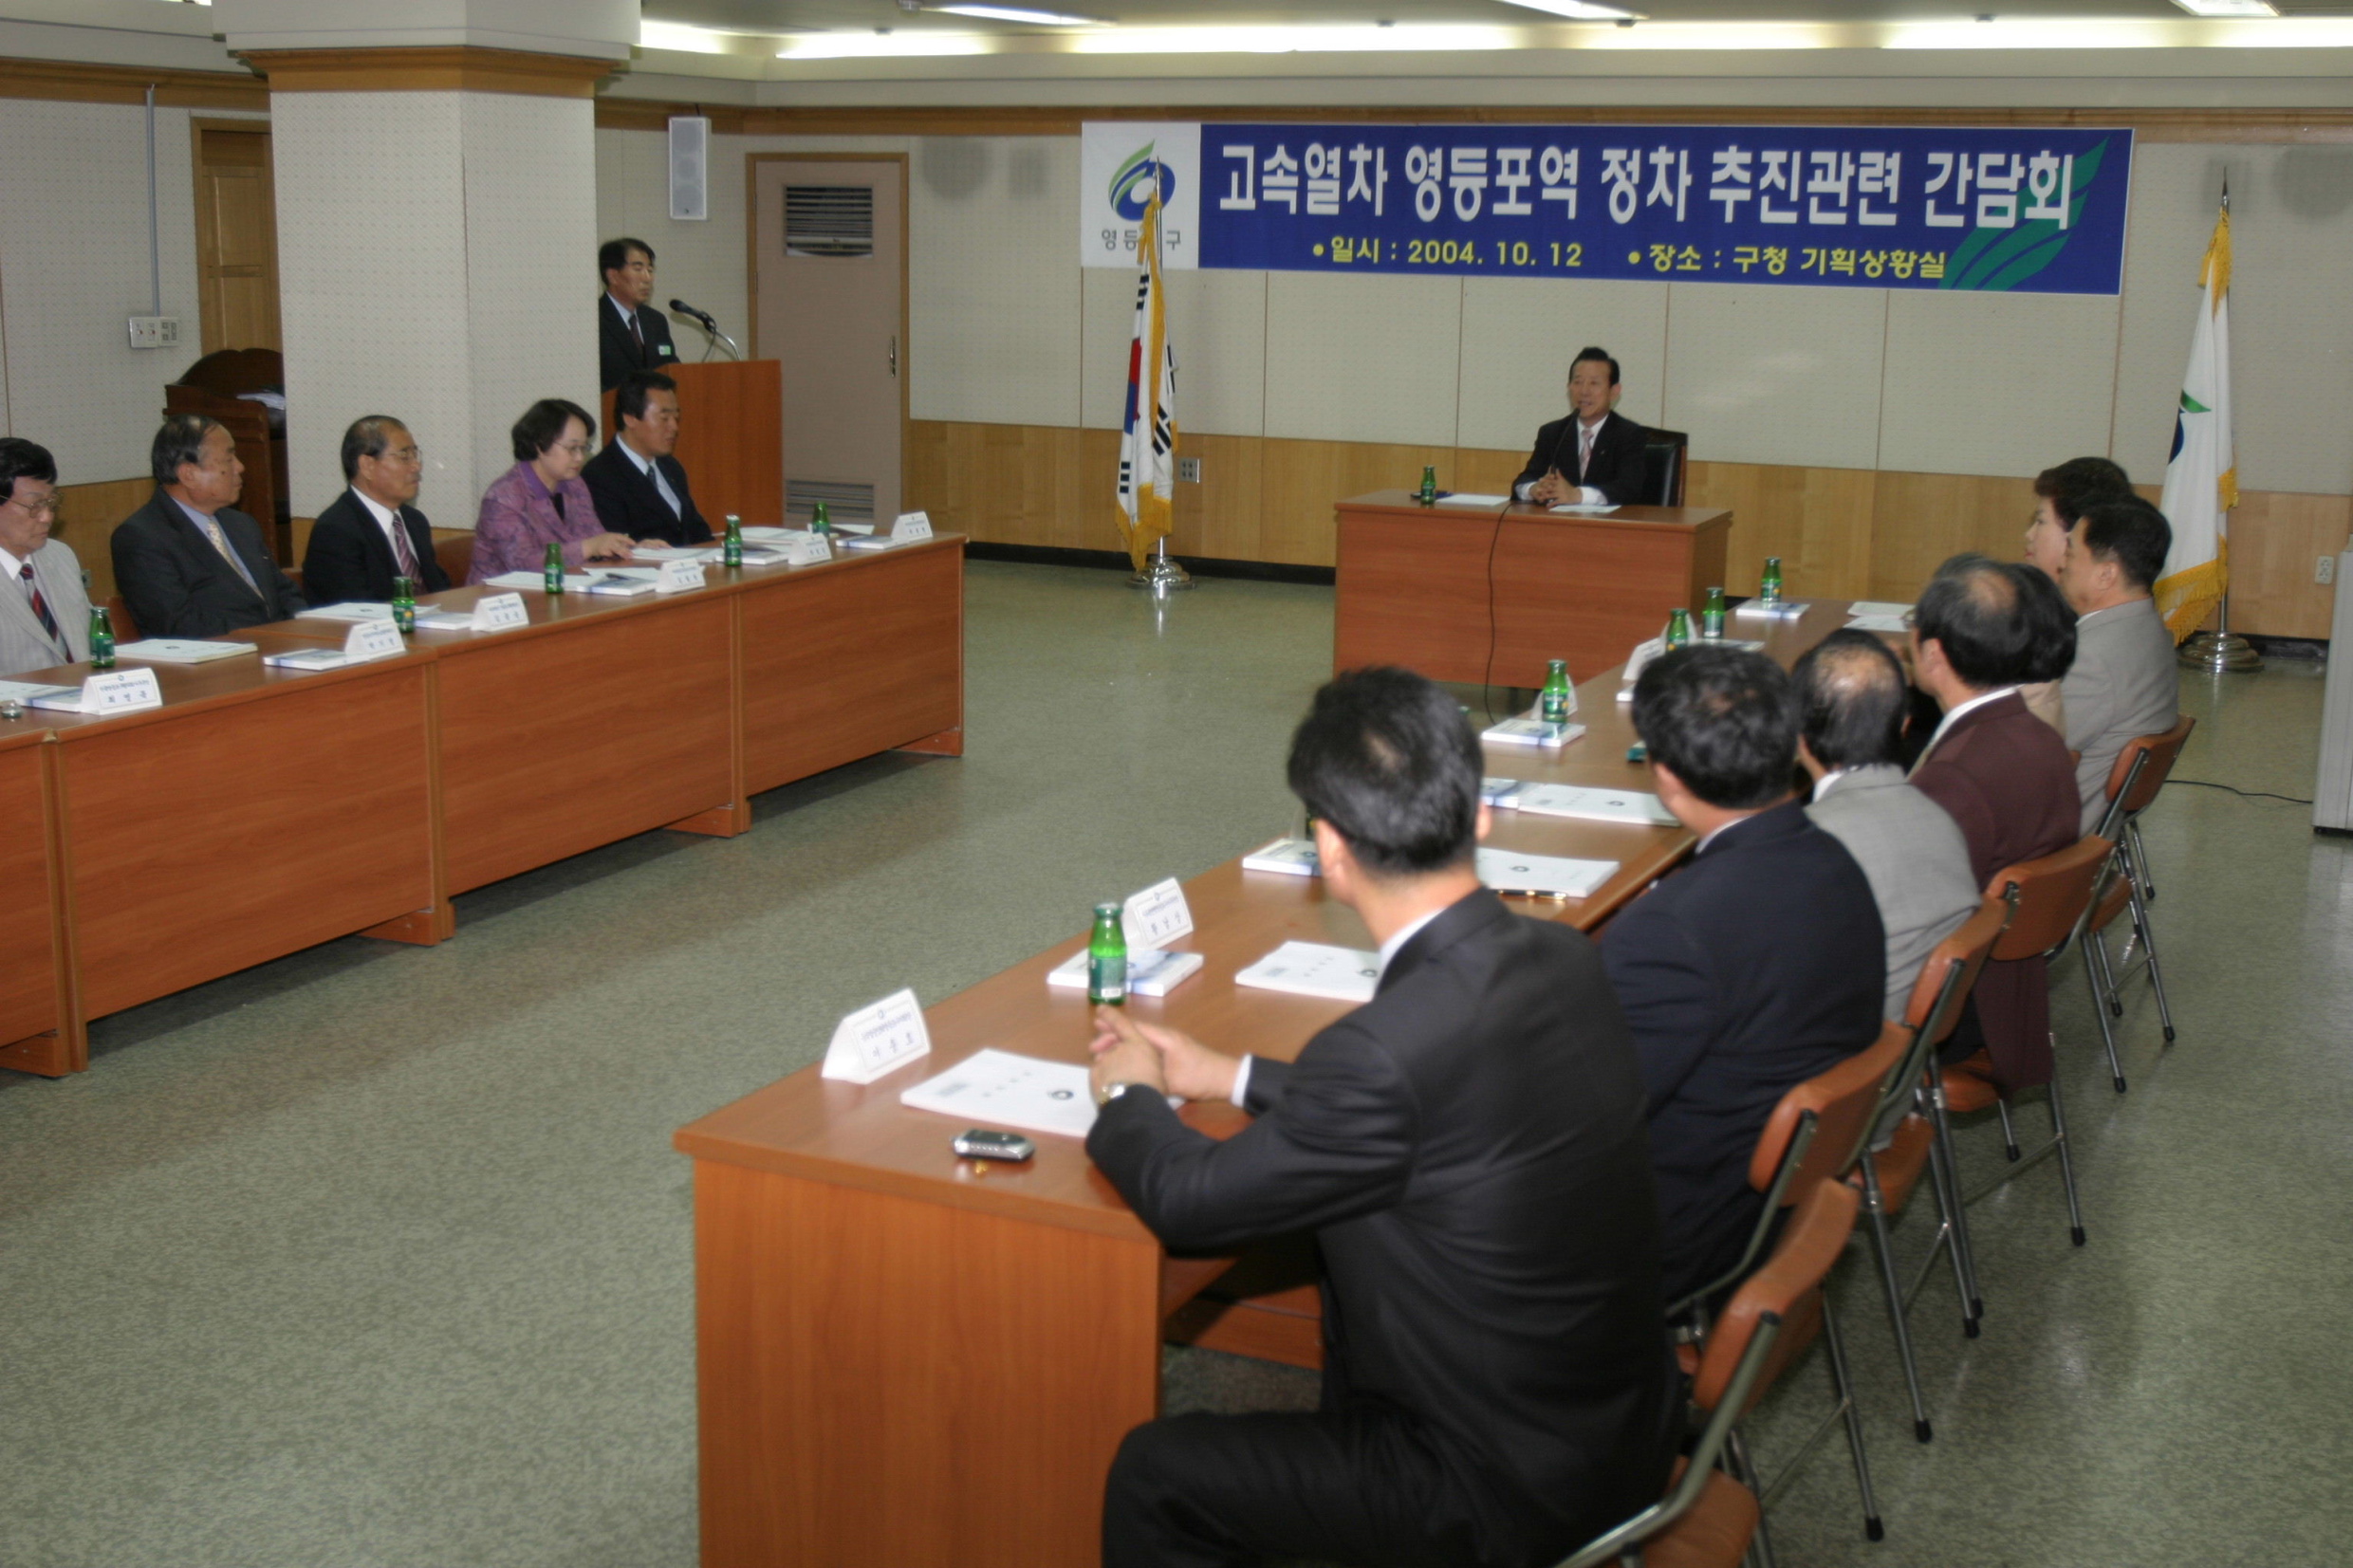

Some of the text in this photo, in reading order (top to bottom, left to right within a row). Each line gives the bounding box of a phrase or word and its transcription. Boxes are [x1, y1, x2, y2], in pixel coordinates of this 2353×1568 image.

[1219, 142, 2074, 230] 고속열차 영등포역 정차 추진관련 간담회
[1101, 229, 1182, 252] 영등구
[1331, 236, 1380, 264] 일시
[1408, 239, 1484, 265] 2004.
[1496, 242, 1536, 266] 10.
[1551, 243, 1584, 267] 12
[1649, 244, 1703, 272] 장소
[1732, 246, 1788, 275] 구청
[1800, 248, 1947, 279] 기획상황실
